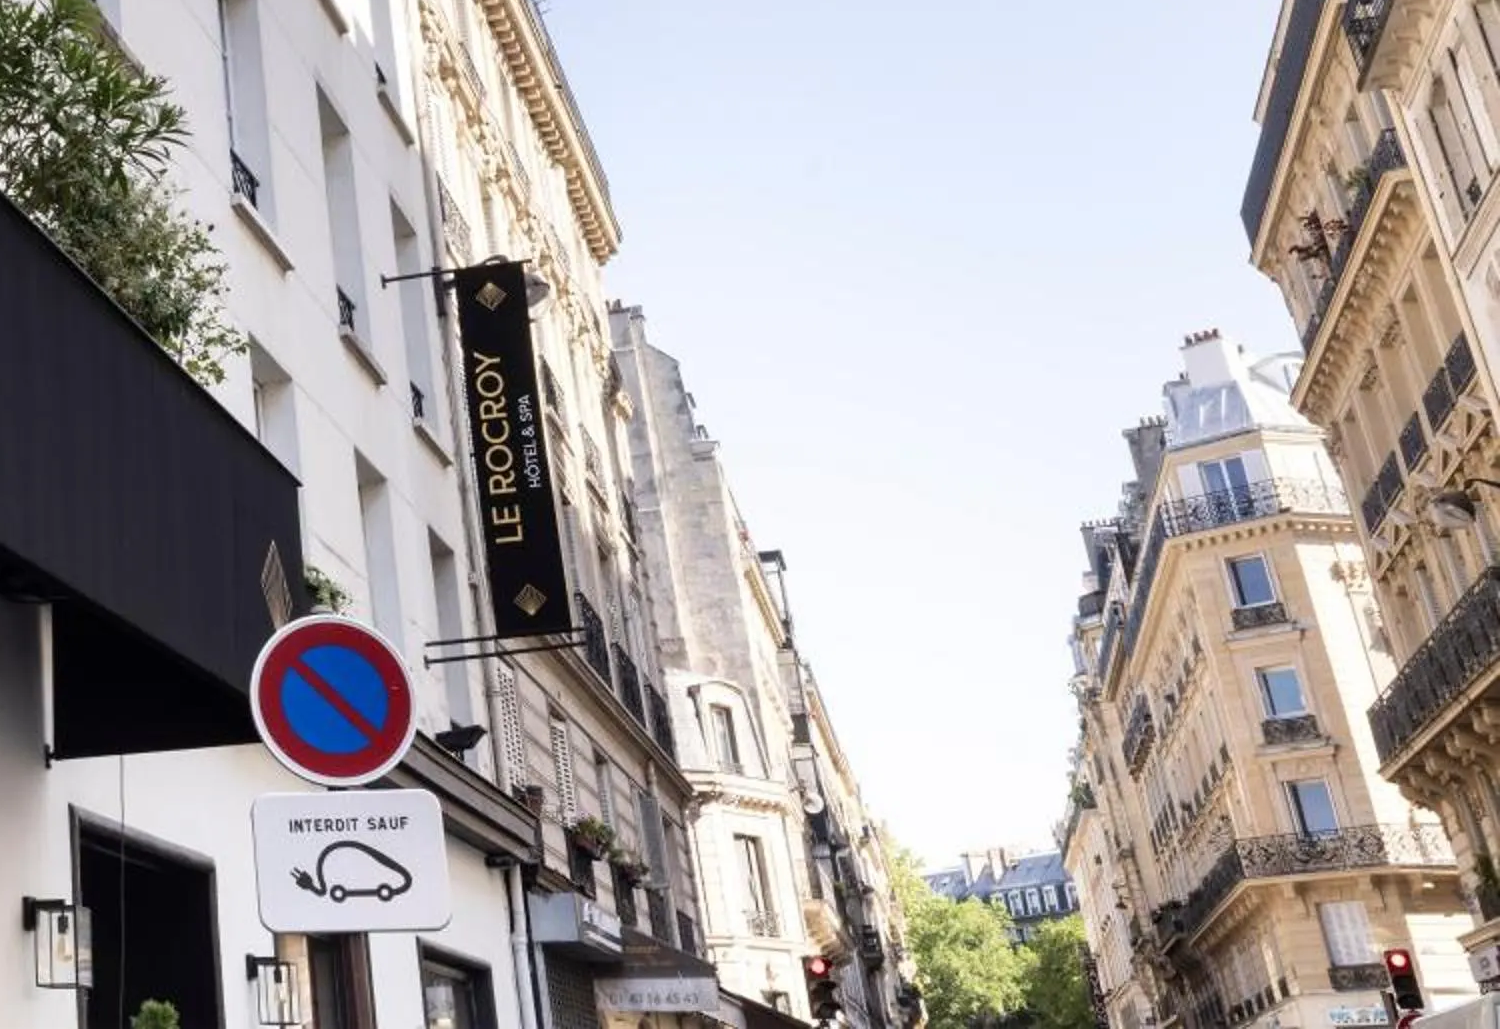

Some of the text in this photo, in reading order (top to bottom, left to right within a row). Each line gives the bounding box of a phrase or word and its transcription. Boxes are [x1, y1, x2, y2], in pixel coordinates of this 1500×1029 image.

[474, 351, 524, 545] LE ROCROY
[517, 393, 542, 489] HÔTEL & SPA
[289, 816, 409, 833] INTERDIT SAUF
